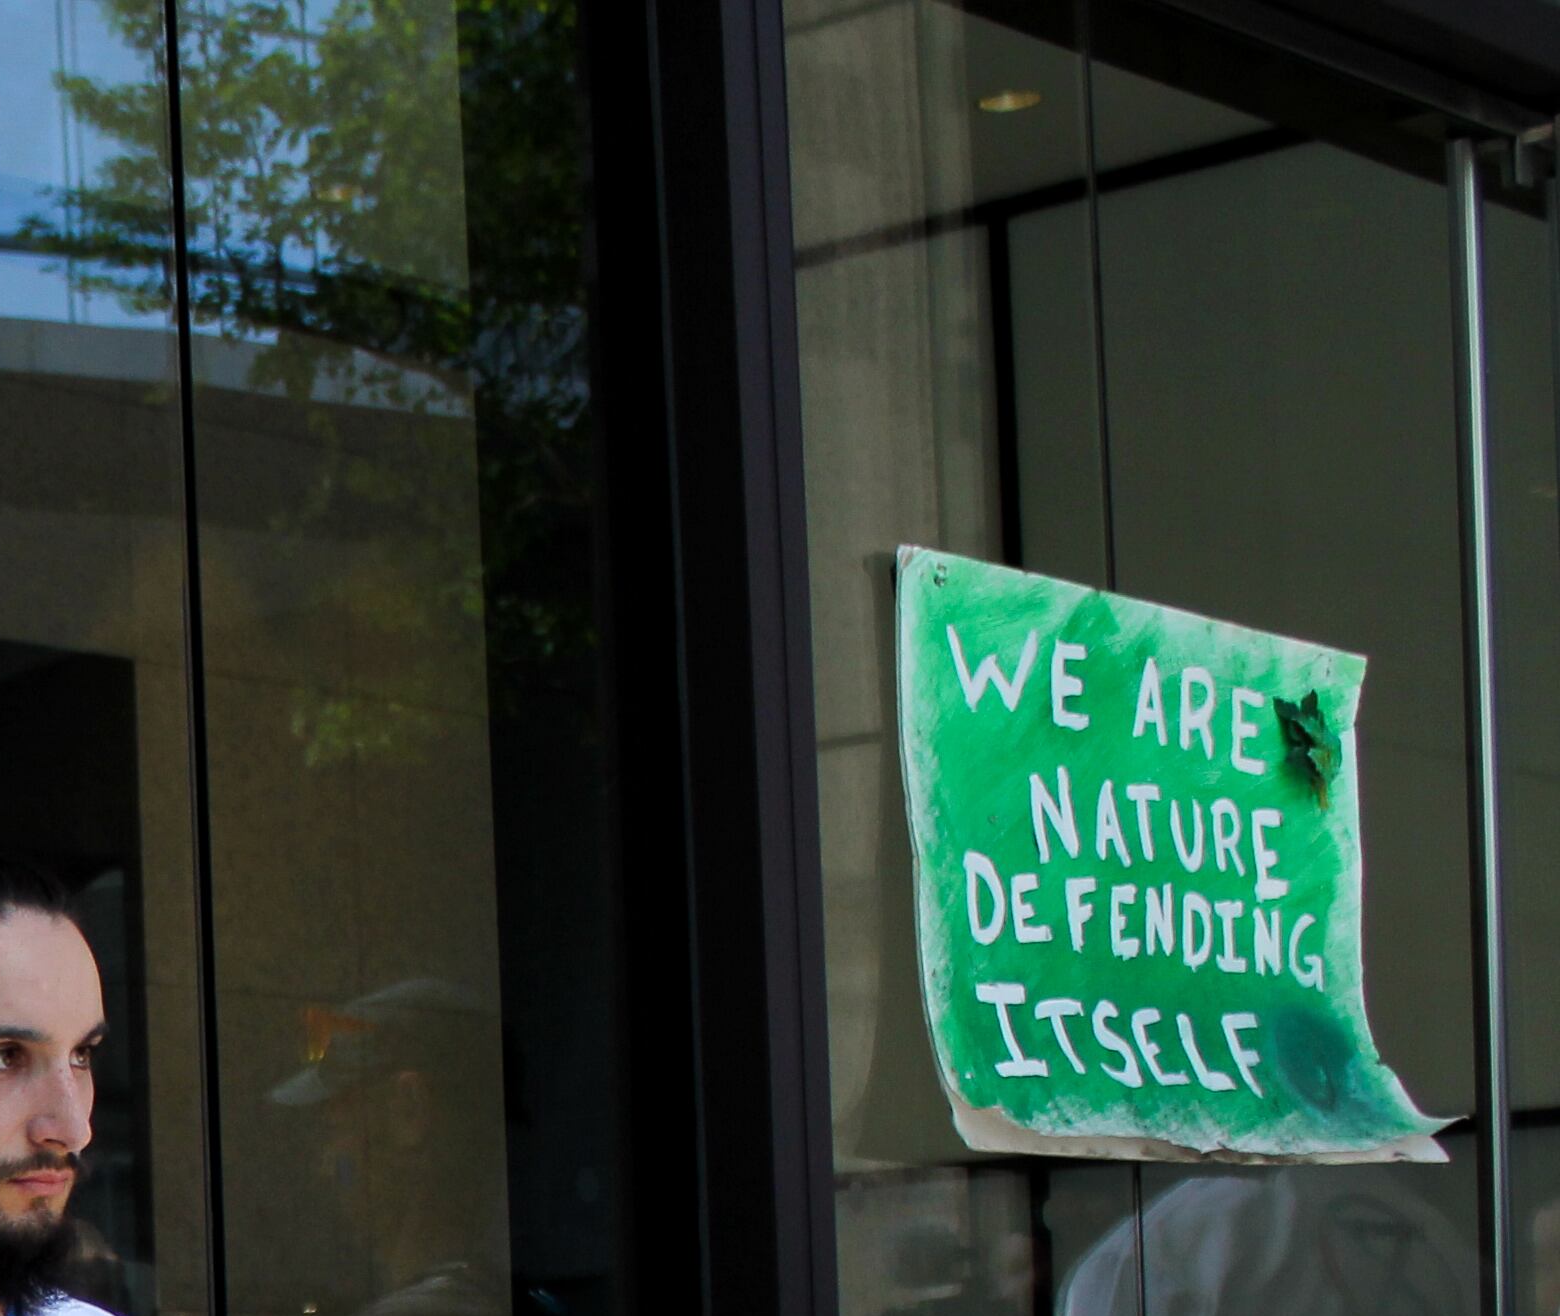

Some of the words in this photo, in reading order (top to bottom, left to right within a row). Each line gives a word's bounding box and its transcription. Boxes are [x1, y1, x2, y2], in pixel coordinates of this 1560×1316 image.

[946, 624, 1090, 731] WE
[1132, 657, 1266, 776] ARE
[1029, 765, 1290, 902] NATURE
[963, 851, 1325, 993] DEFENDING
[975, 982, 1265, 1099] ITSELF
